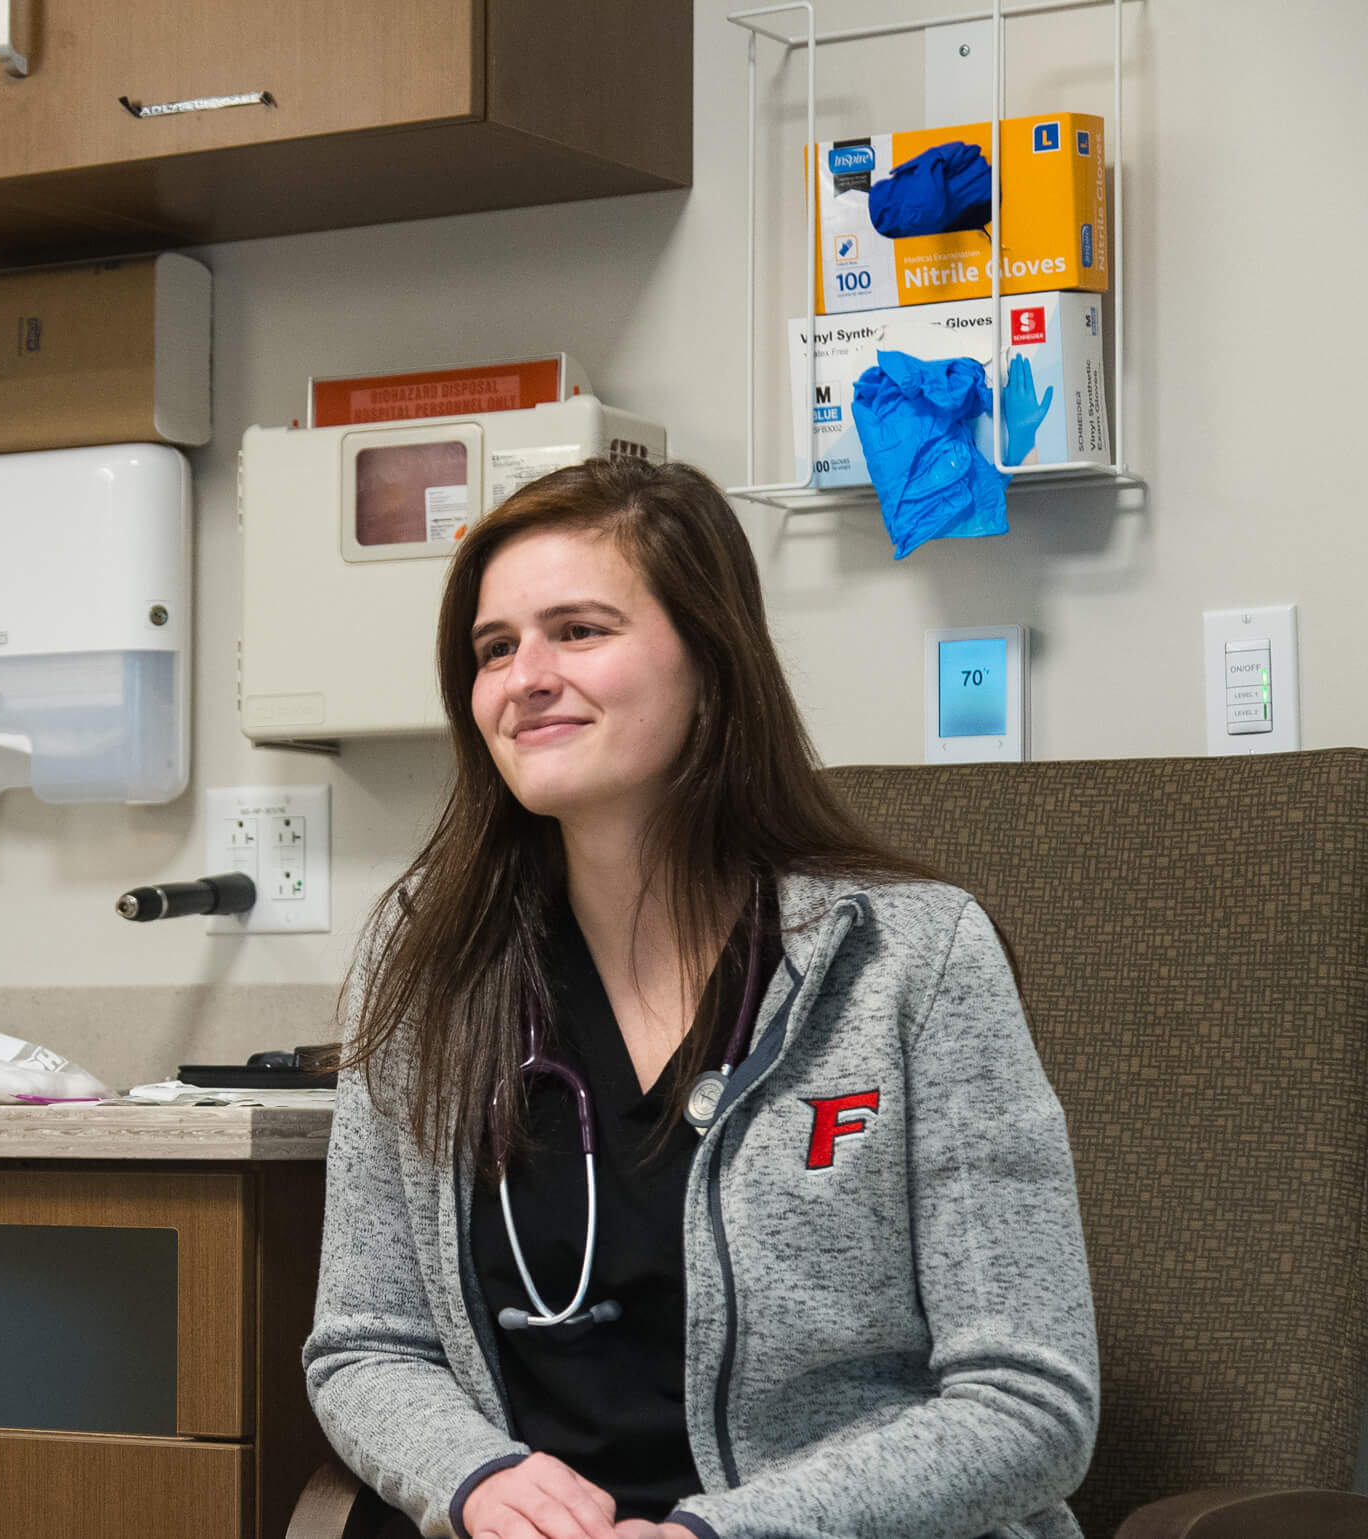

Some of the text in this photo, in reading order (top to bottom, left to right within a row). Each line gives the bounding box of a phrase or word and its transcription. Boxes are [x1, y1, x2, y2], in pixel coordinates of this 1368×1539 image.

[1042, 130, 1052, 146] L
[1095, 133, 1105, 271] Nitrile Gloves
[836, 270, 871, 291] 100
[904, 262, 979, 288] Nitrile
[946, 316, 993, 328] Gloves
[800, 331, 833, 345] Vnyl
[371, 380, 498, 403] BIOHAZARD DISPOSAL
[816, 386, 831, 404] M
[415, 398, 482, 416] PERSONNEL
[1085, 360, 1097, 451] Vinyl Synthetic
[1230, 663, 1261, 673] ON/OFF
[797, 1088, 880, 1174] F
